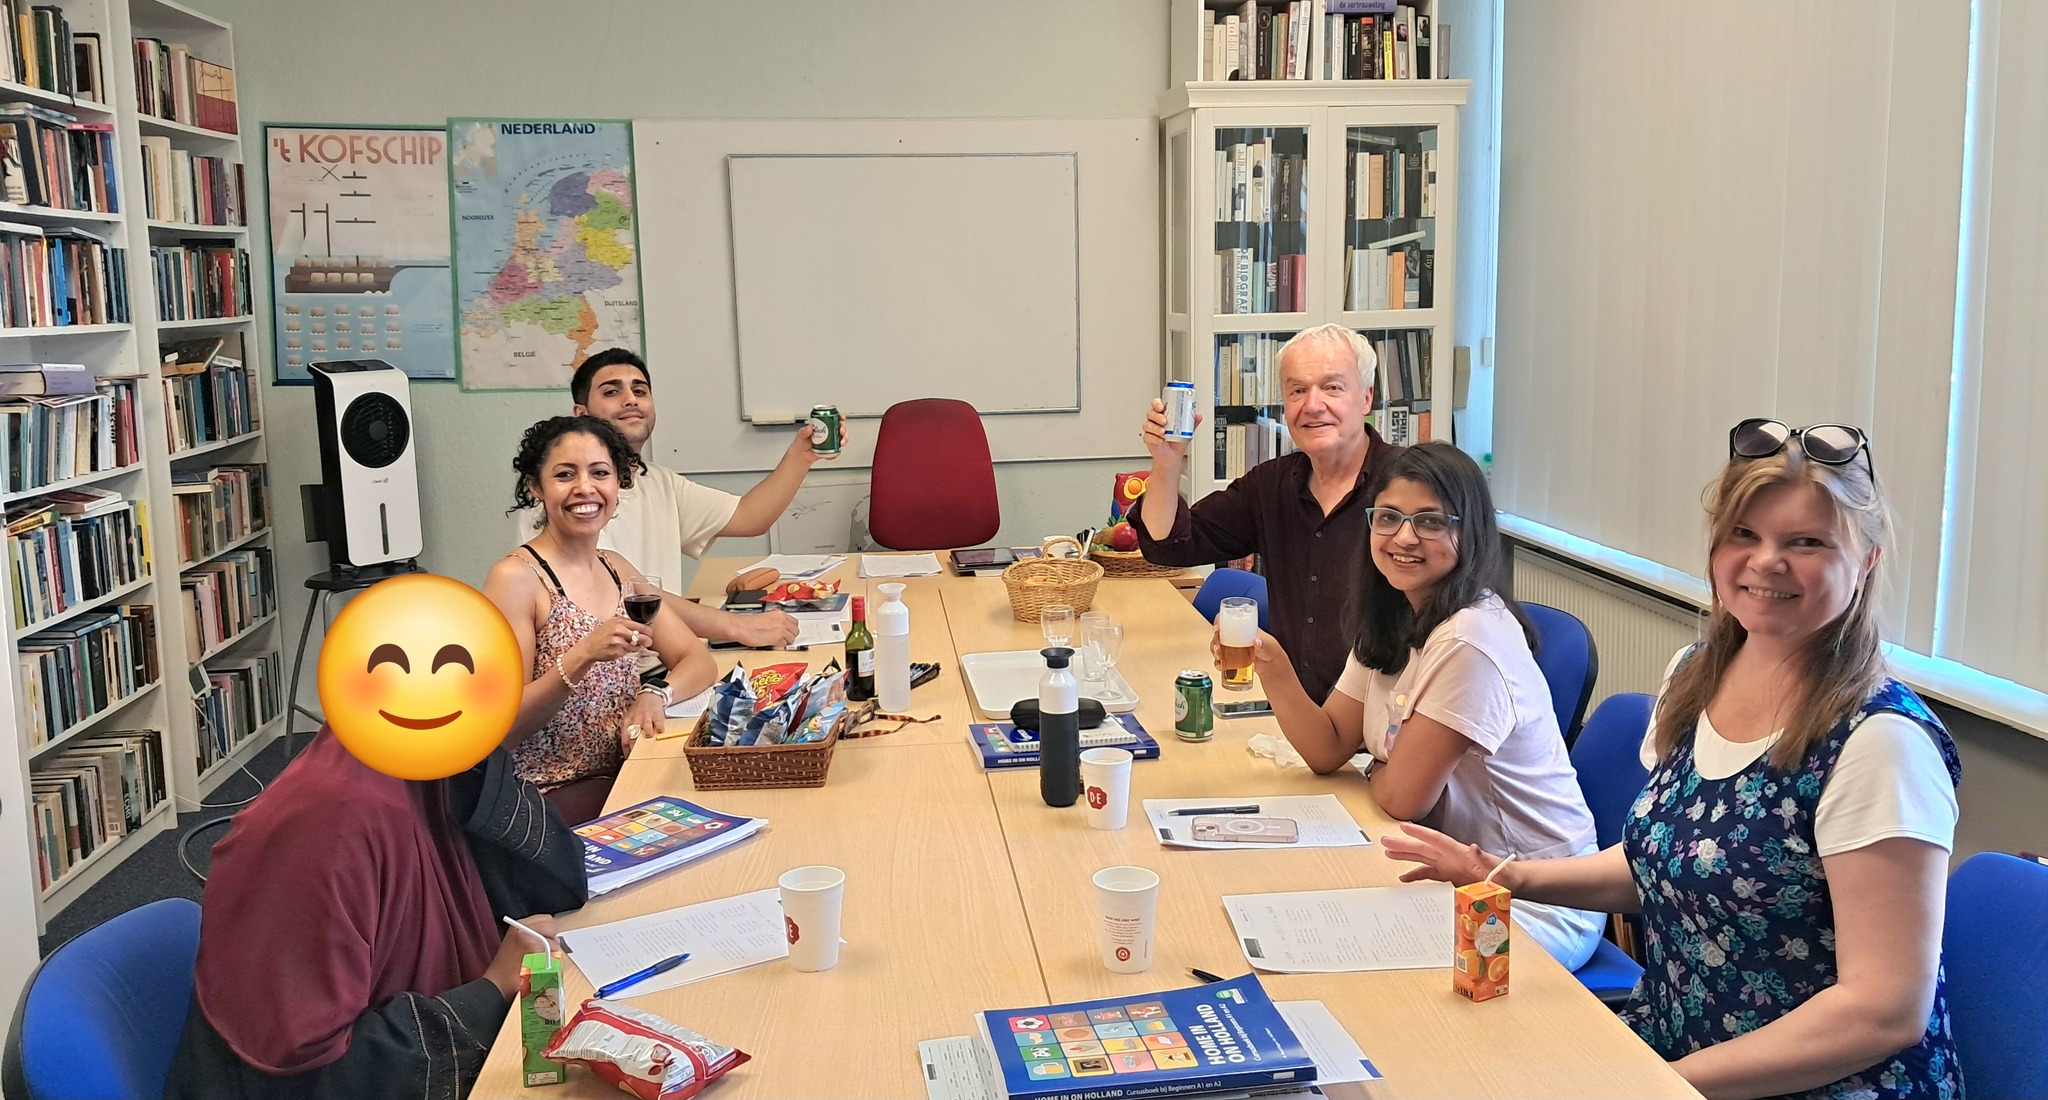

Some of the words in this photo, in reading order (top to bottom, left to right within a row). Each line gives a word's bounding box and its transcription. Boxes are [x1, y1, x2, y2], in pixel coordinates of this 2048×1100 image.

[501, 123, 595, 134] NEDERLAND
[299, 134, 442, 165] KOFSCHIP
[1188, 1024, 1208, 1035] IN
[1196, 1004, 1237, 1046] HOLLAND
[1195, 1035, 1227, 1065] HOME
[1223, 1046, 1245, 1063] ON
[1084, 1089, 1123, 1099] HOLLAND
[1127, 1088, 1159, 1096] Cursusboek
[1160, 1086, 1168, 1094] bij
[1168, 1084, 1196, 1093] Beginners
